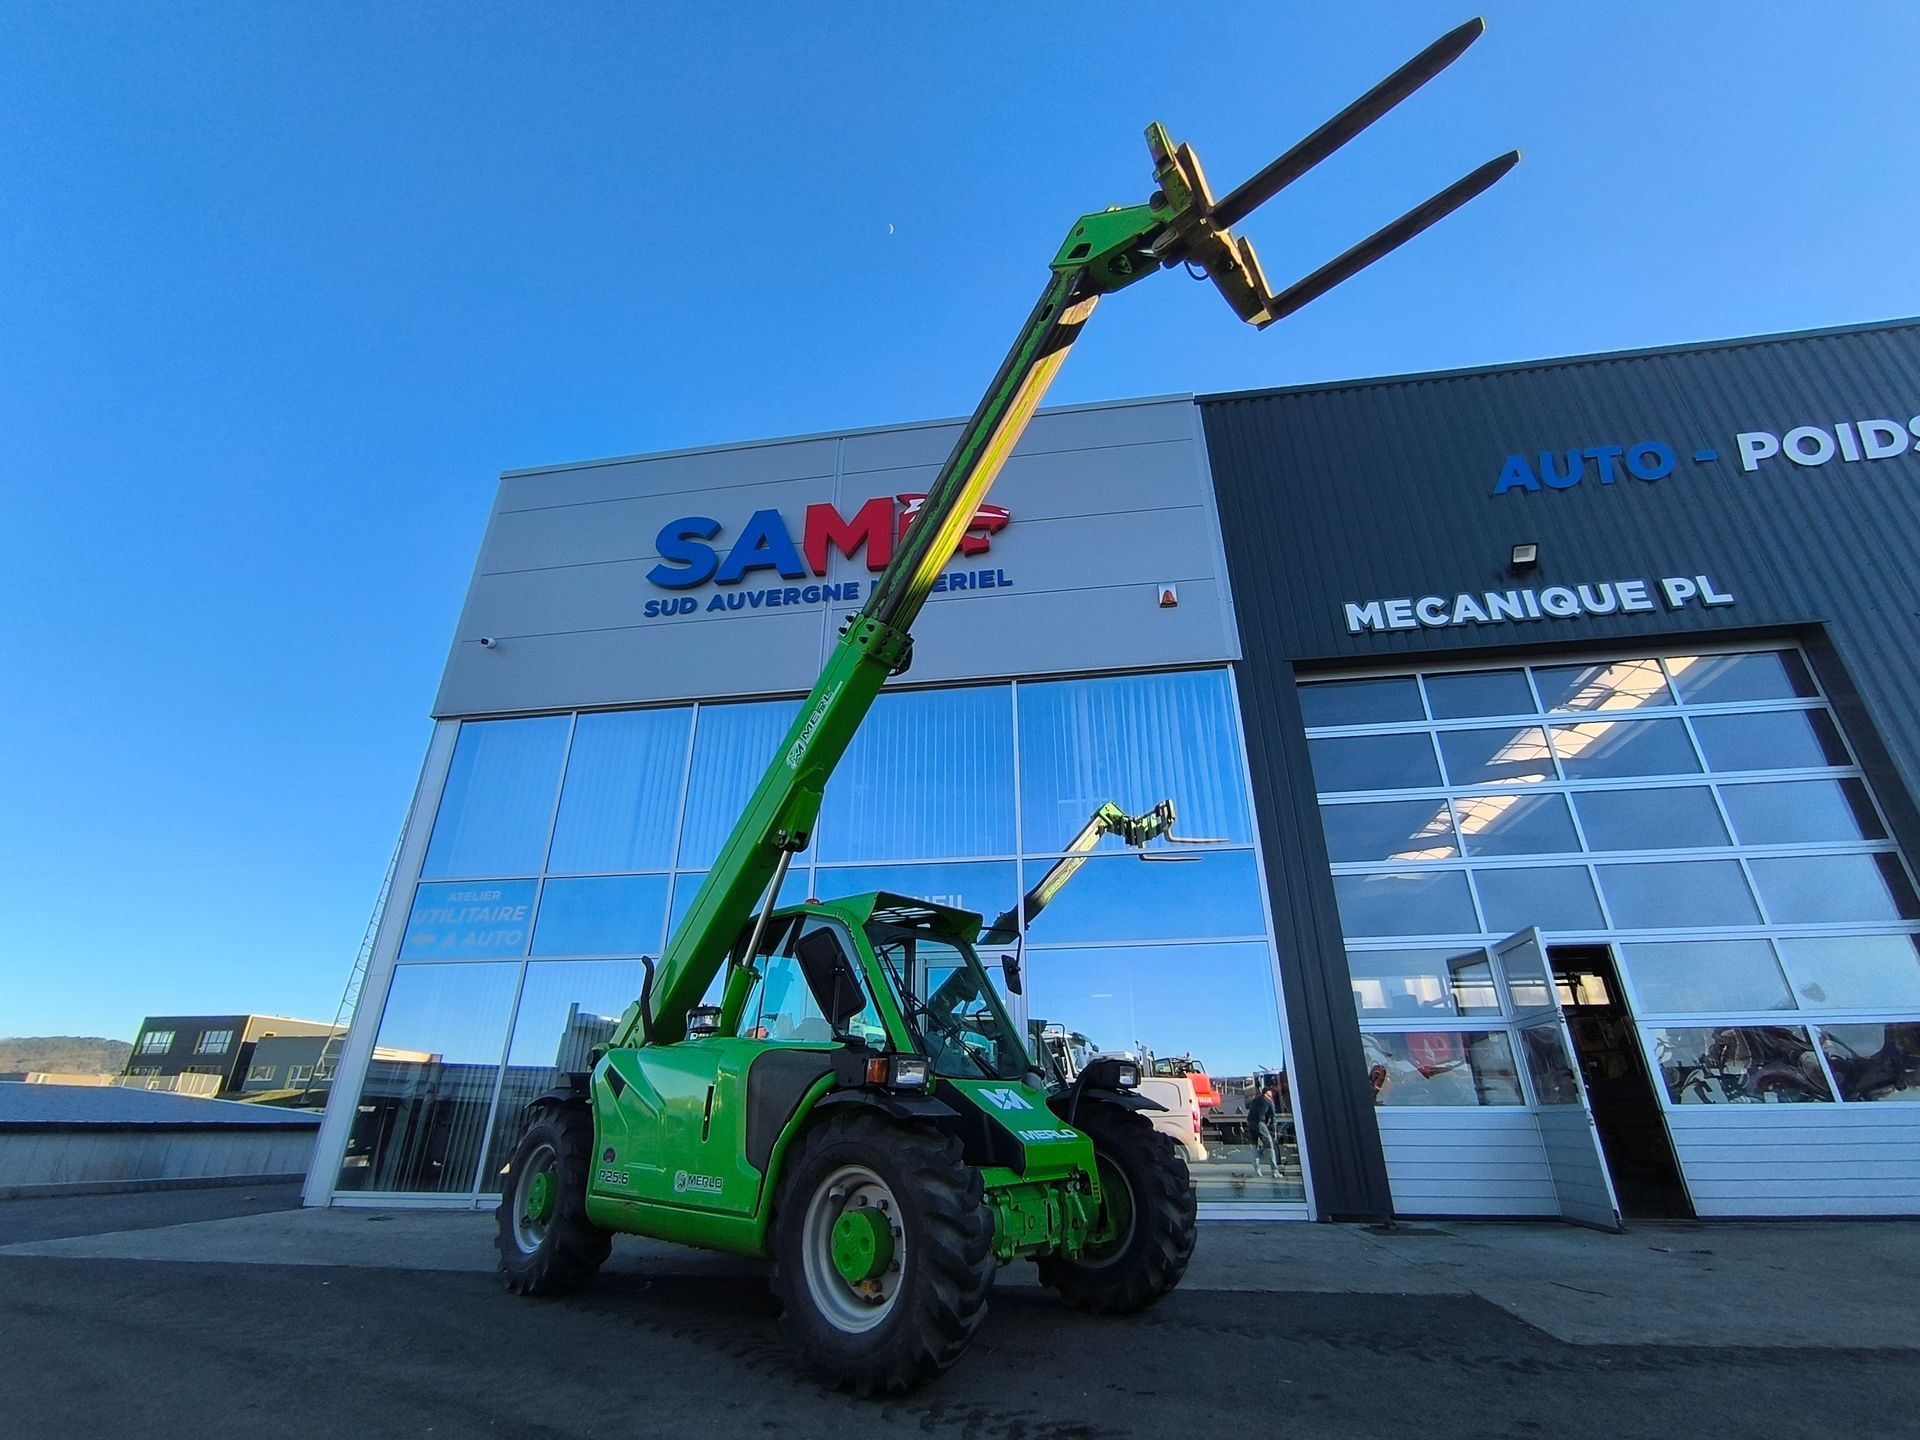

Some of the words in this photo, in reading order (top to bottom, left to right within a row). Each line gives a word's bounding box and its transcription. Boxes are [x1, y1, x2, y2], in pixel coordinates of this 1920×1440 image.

[1493, 441, 1676, 495] AUTO
[643, 597, 698, 618] SUD
[705, 581, 860, 613] AUVERGNE
[871, 569, 1013, 597] ERIEL
[1344, 580, 1656, 635] MECANIQUE
[1660, 574, 1735, 612] PL
[449, 890, 501, 902] ATELIER
[414, 906, 527, 924] UTILITAIRE
[463, 929, 522, 946] AUTO
[1018, 1129, 1078, 1140] MERLO
[688, 1173, 723, 1189] MERLO
